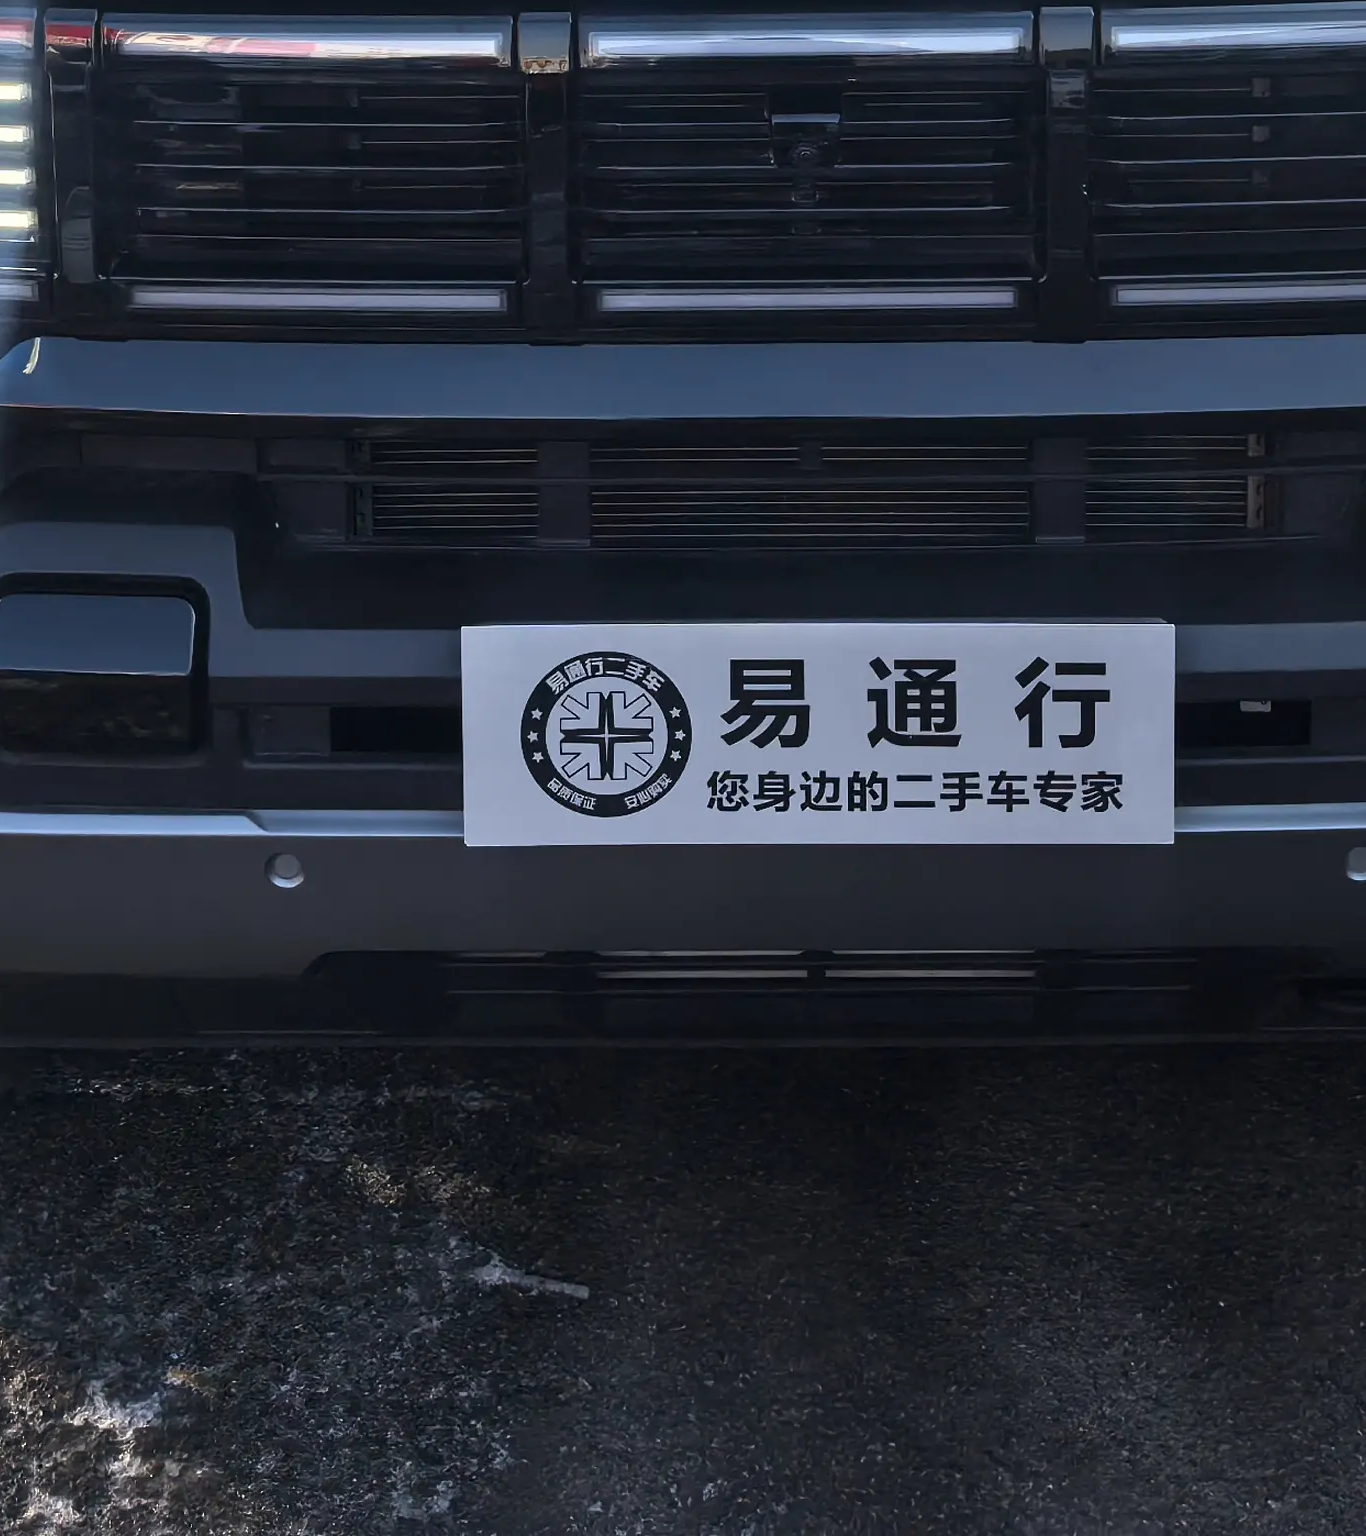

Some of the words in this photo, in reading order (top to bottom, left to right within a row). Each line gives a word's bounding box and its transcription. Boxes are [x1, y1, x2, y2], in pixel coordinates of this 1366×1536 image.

[545, 657, 666, 696] 易通行二手车
[720, 655, 1112, 750] 易通行
[547, 777, 597, 811] 品质保证
[707, 769, 1125, 814] 您身边的二手车专家
